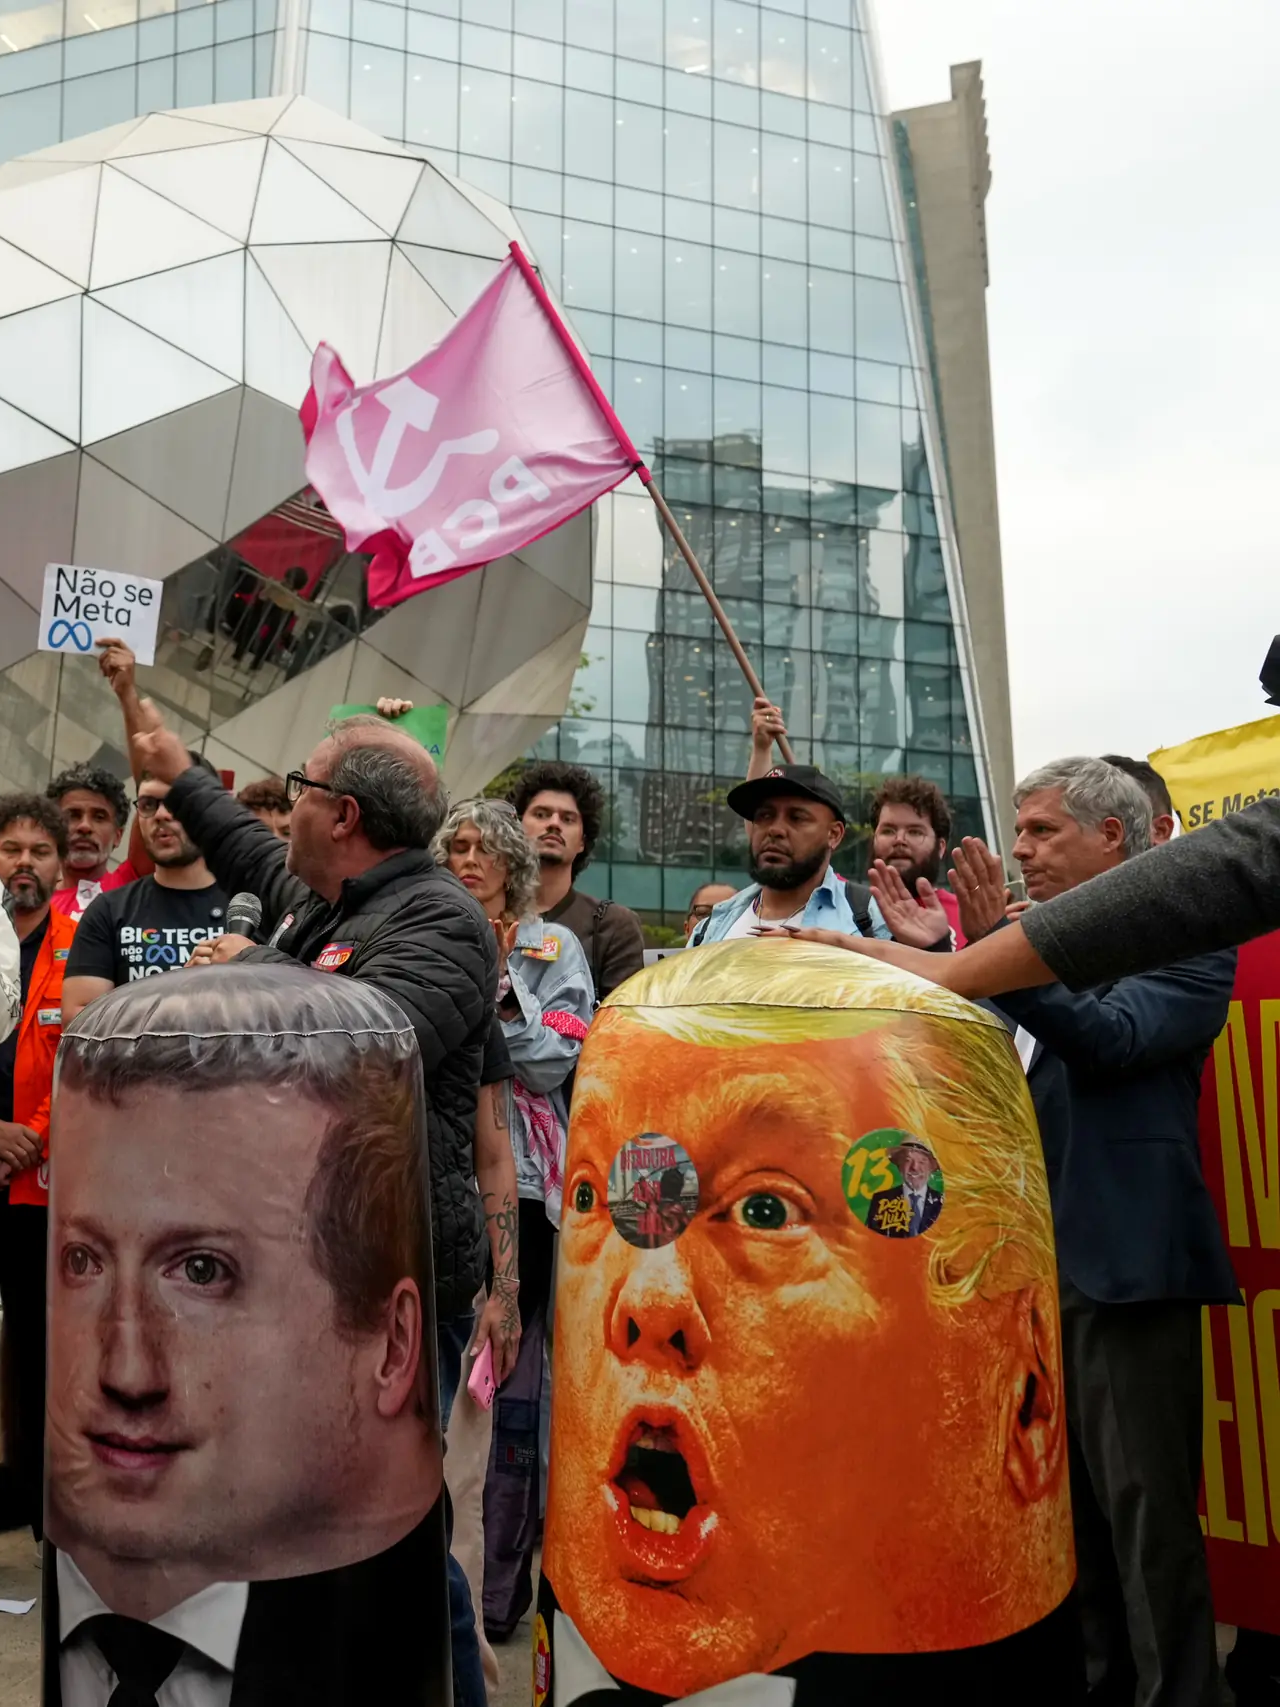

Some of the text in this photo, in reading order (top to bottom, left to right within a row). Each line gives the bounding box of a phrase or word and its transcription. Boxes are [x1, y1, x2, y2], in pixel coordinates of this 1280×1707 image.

[55, 567, 153, 606] Não se
[53, 593, 132, 627] Meta
[1188, 800, 1214, 828] SE
[121, 945, 143, 956] não
[846, 1147, 894, 1200] 13
